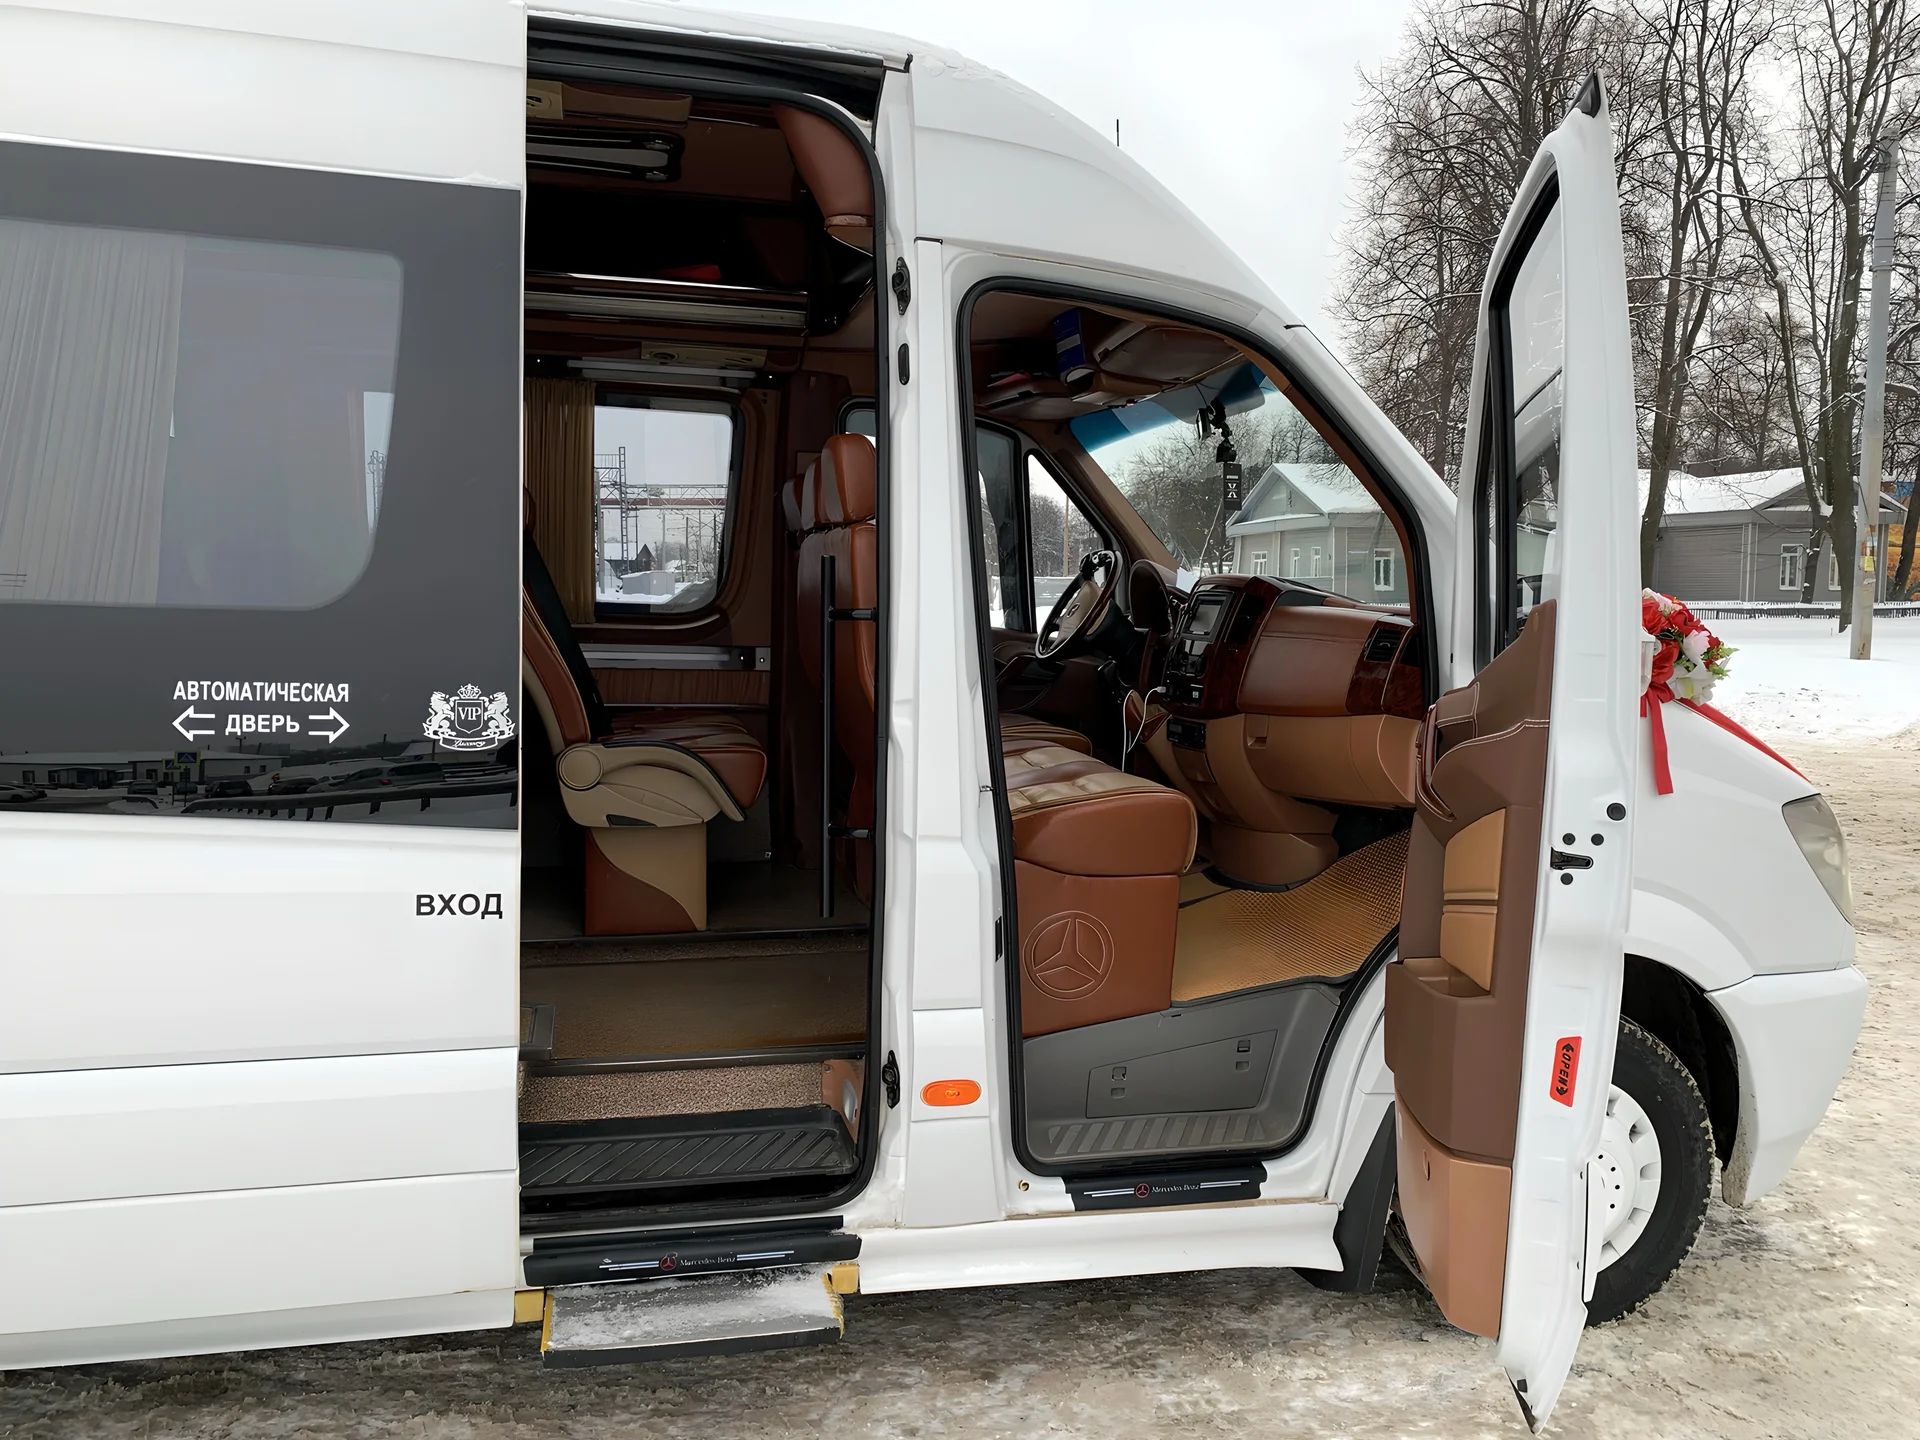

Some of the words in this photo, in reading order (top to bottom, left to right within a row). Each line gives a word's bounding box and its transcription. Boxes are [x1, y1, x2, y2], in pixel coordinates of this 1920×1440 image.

[173, 680, 349, 703] АВТОМАТИЧЕСКАЯ
[225, 714, 300, 736] ДВЕРЬ
[458, 706, 482, 721] VIP
[416, 893, 503, 919] ВХОД
[1557, 1052, 1572, 1087] OPEN
